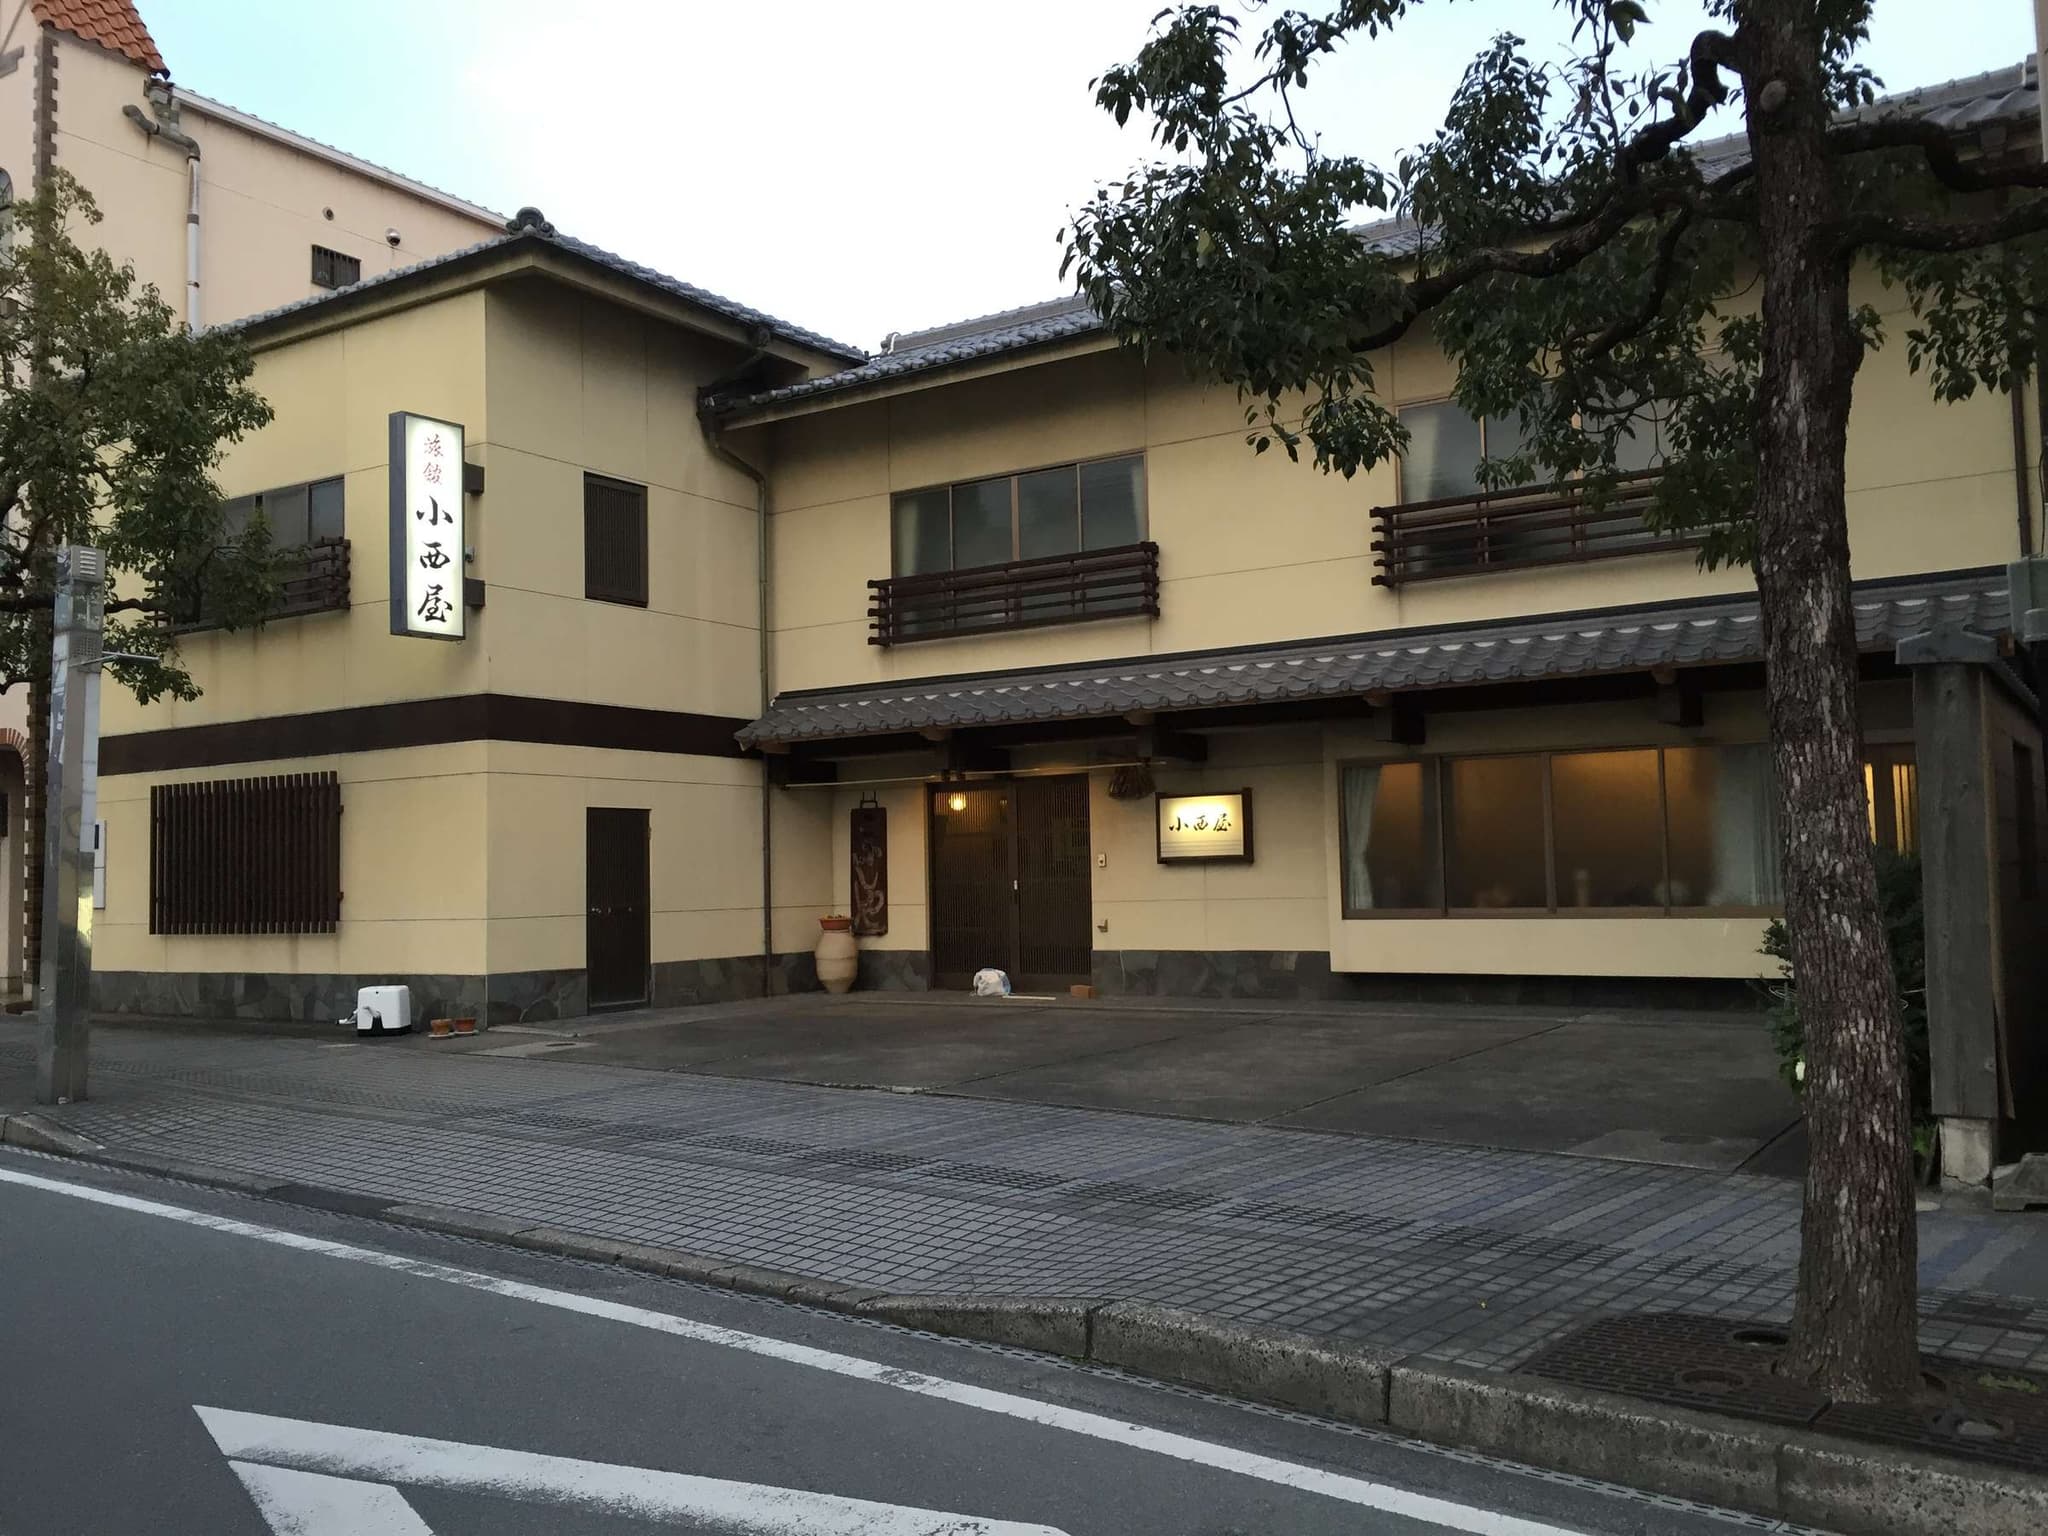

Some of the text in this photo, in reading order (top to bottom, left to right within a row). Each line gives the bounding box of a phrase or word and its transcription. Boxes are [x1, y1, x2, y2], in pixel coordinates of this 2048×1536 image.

[416, 495, 453, 623] 小西屋
[1168, 812, 1232, 832] 小西屋
